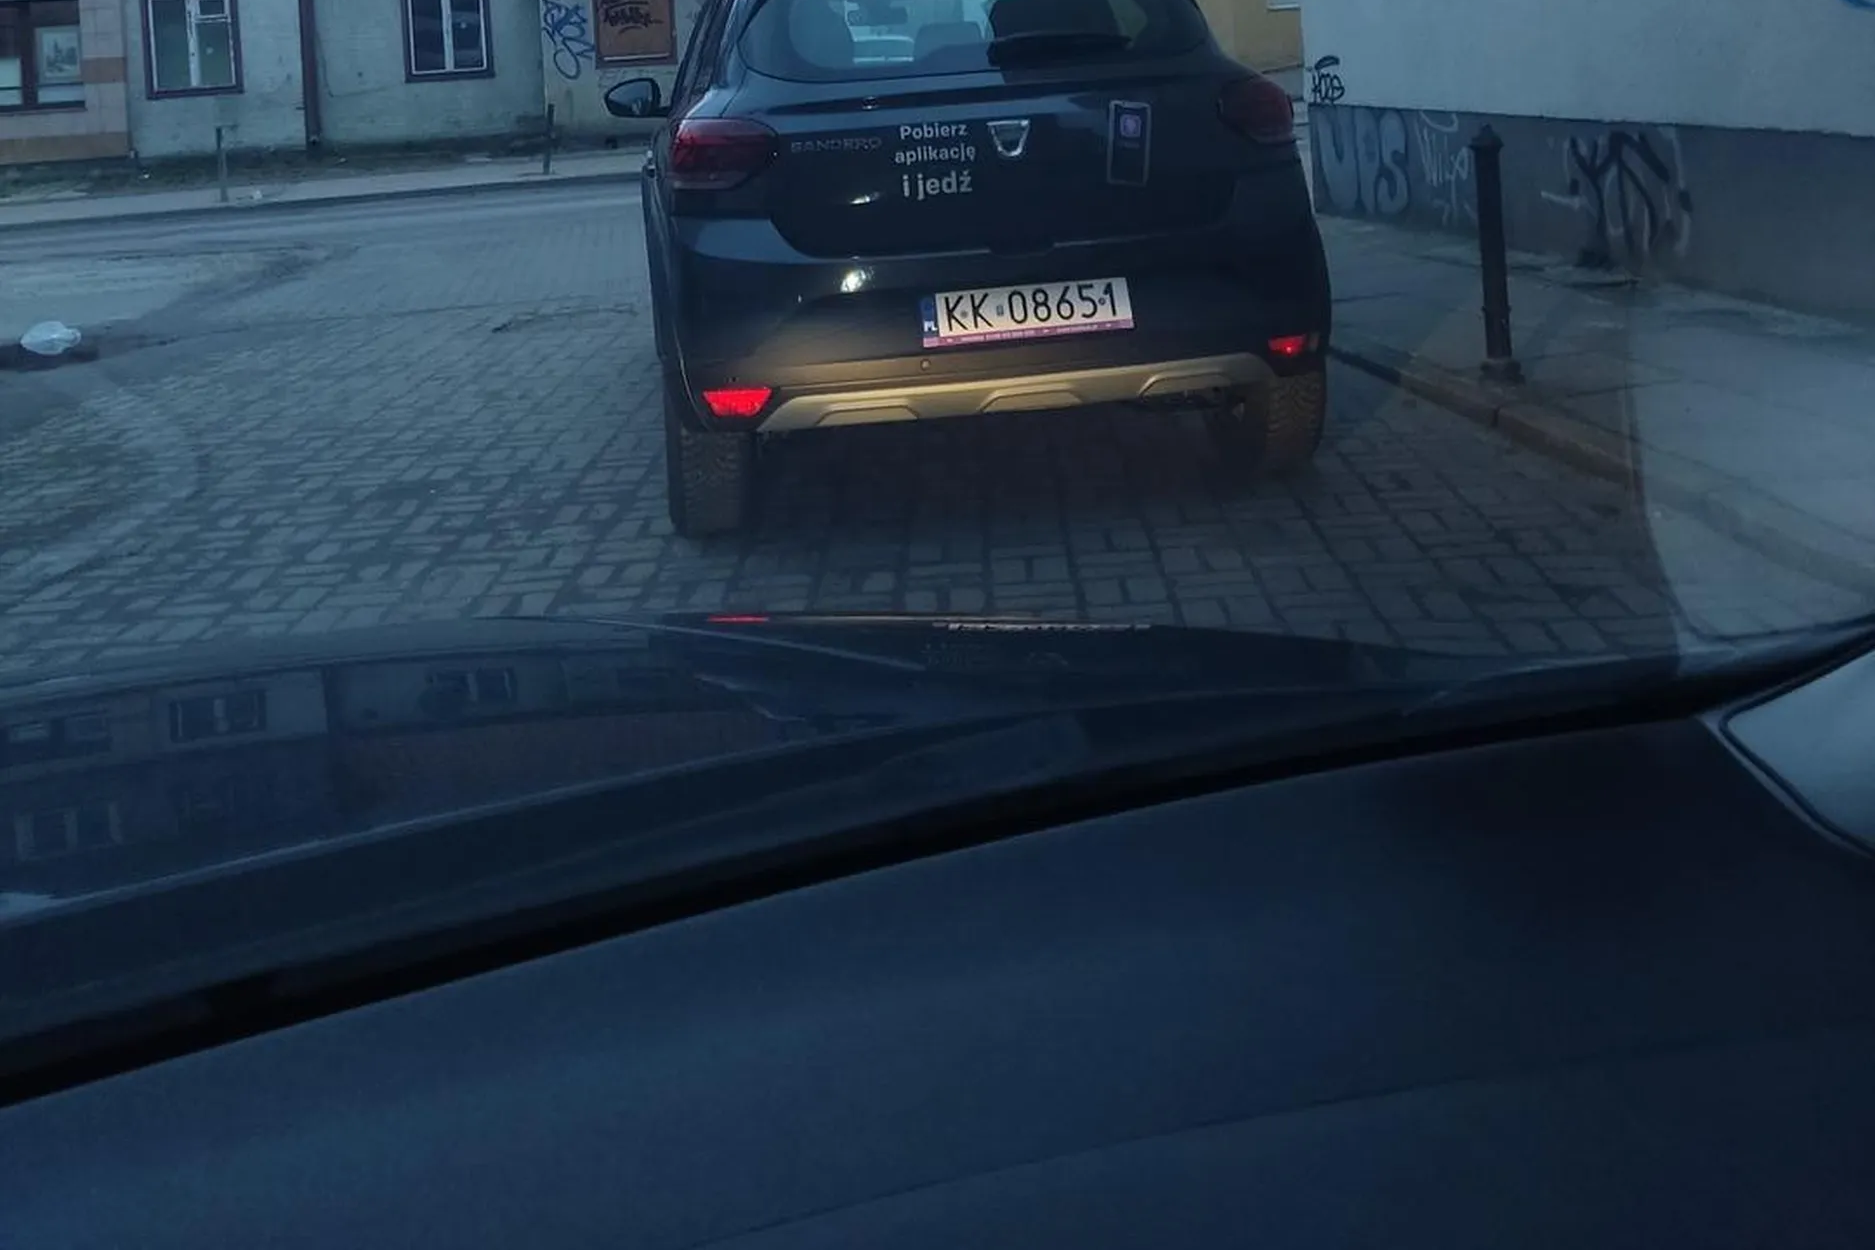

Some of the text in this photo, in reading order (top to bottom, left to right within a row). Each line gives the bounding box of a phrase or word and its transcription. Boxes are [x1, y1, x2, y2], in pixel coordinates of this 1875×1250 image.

[899, 122, 968, 141] Pobierz
[894, 142, 977, 165] aplikację
[902, 169, 974, 201] i jedź
[943, 280, 1118, 332] KK 08651
[922, 320, 938, 333] PL
